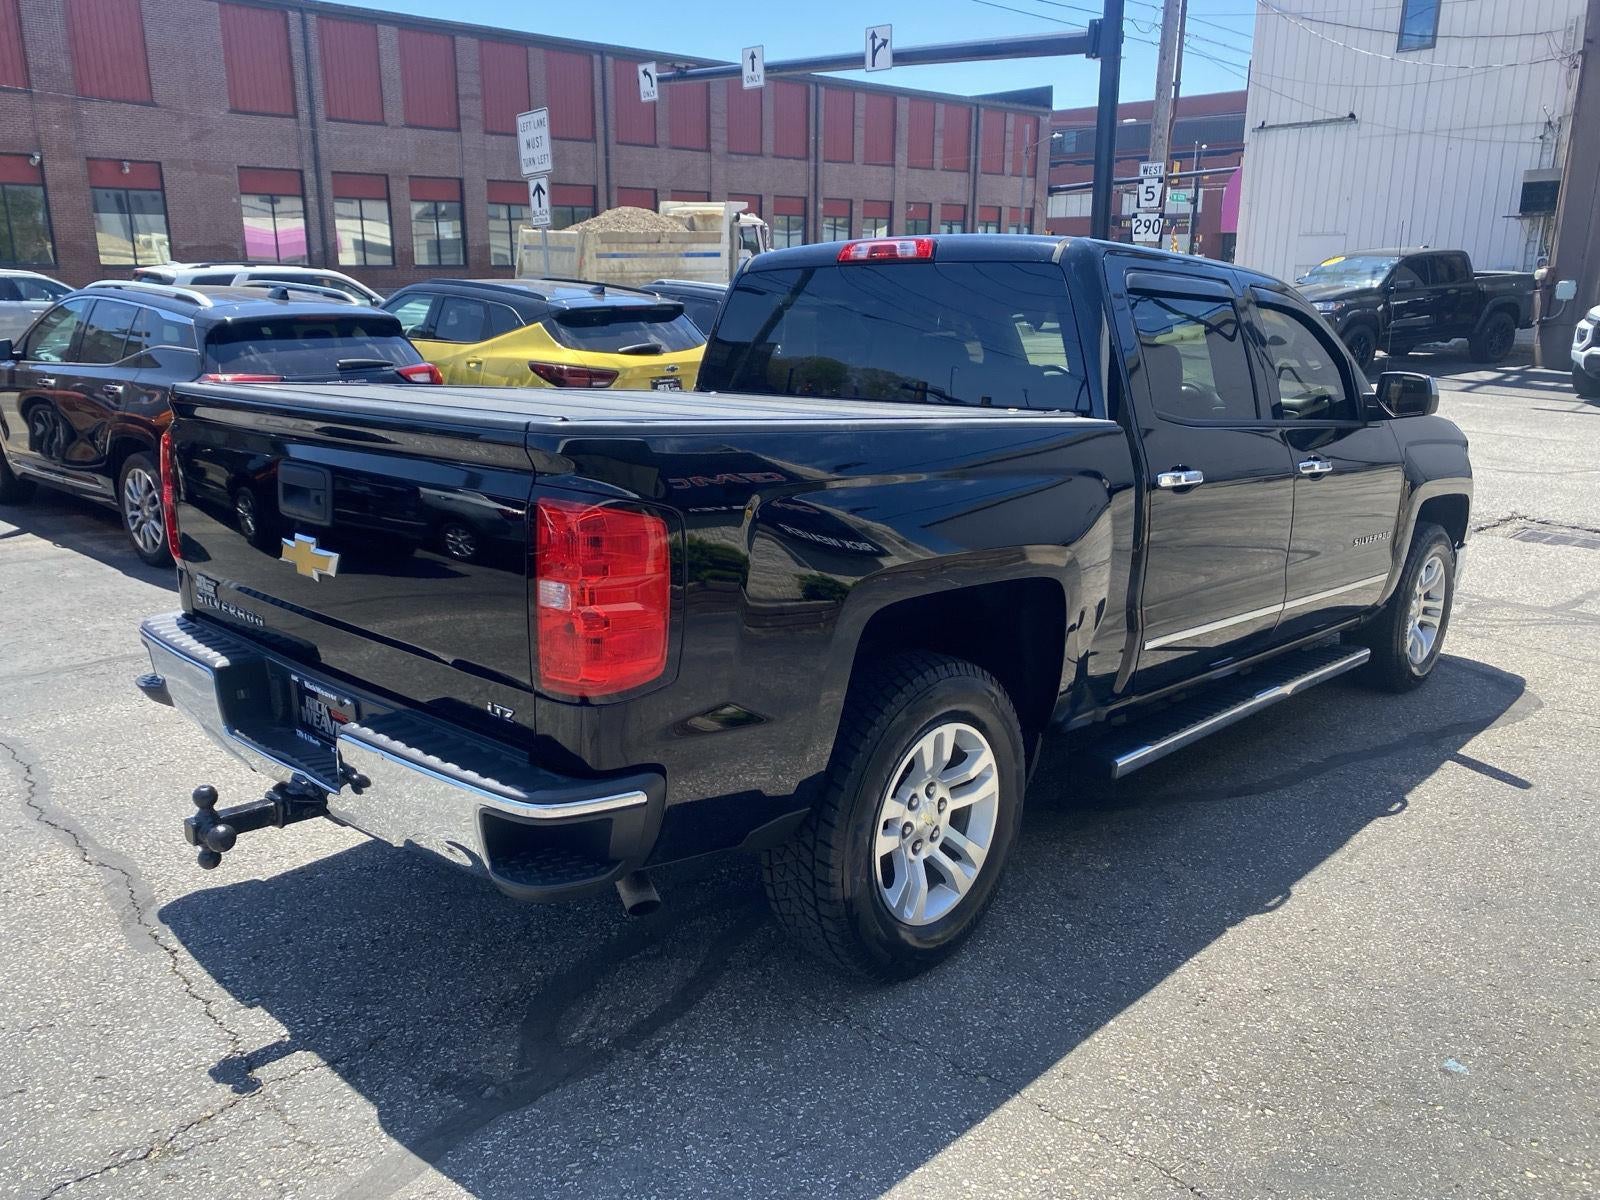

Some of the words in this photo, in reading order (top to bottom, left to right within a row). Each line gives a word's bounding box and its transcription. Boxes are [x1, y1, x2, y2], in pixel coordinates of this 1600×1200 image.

[746, 74, 762, 84] ONLY
[643, 90, 655, 98] ONLY
[520, 120, 531, 133] LEFT
[533, 117, 546, 129] LANE
[526, 136, 543, 150] MUST
[523, 157, 536, 167] TURN
[537, 153, 550, 165] LEFT
[1142, 165, 1162, 175] WEST
[1144, 186, 1155, 201] 5
[1133, 219, 1160, 234] 290
[1352, 531, 1391, 547] SILVERADO
[196, 593, 264, 627] SILVERADO
[487, 701, 514, 723] LTZ
